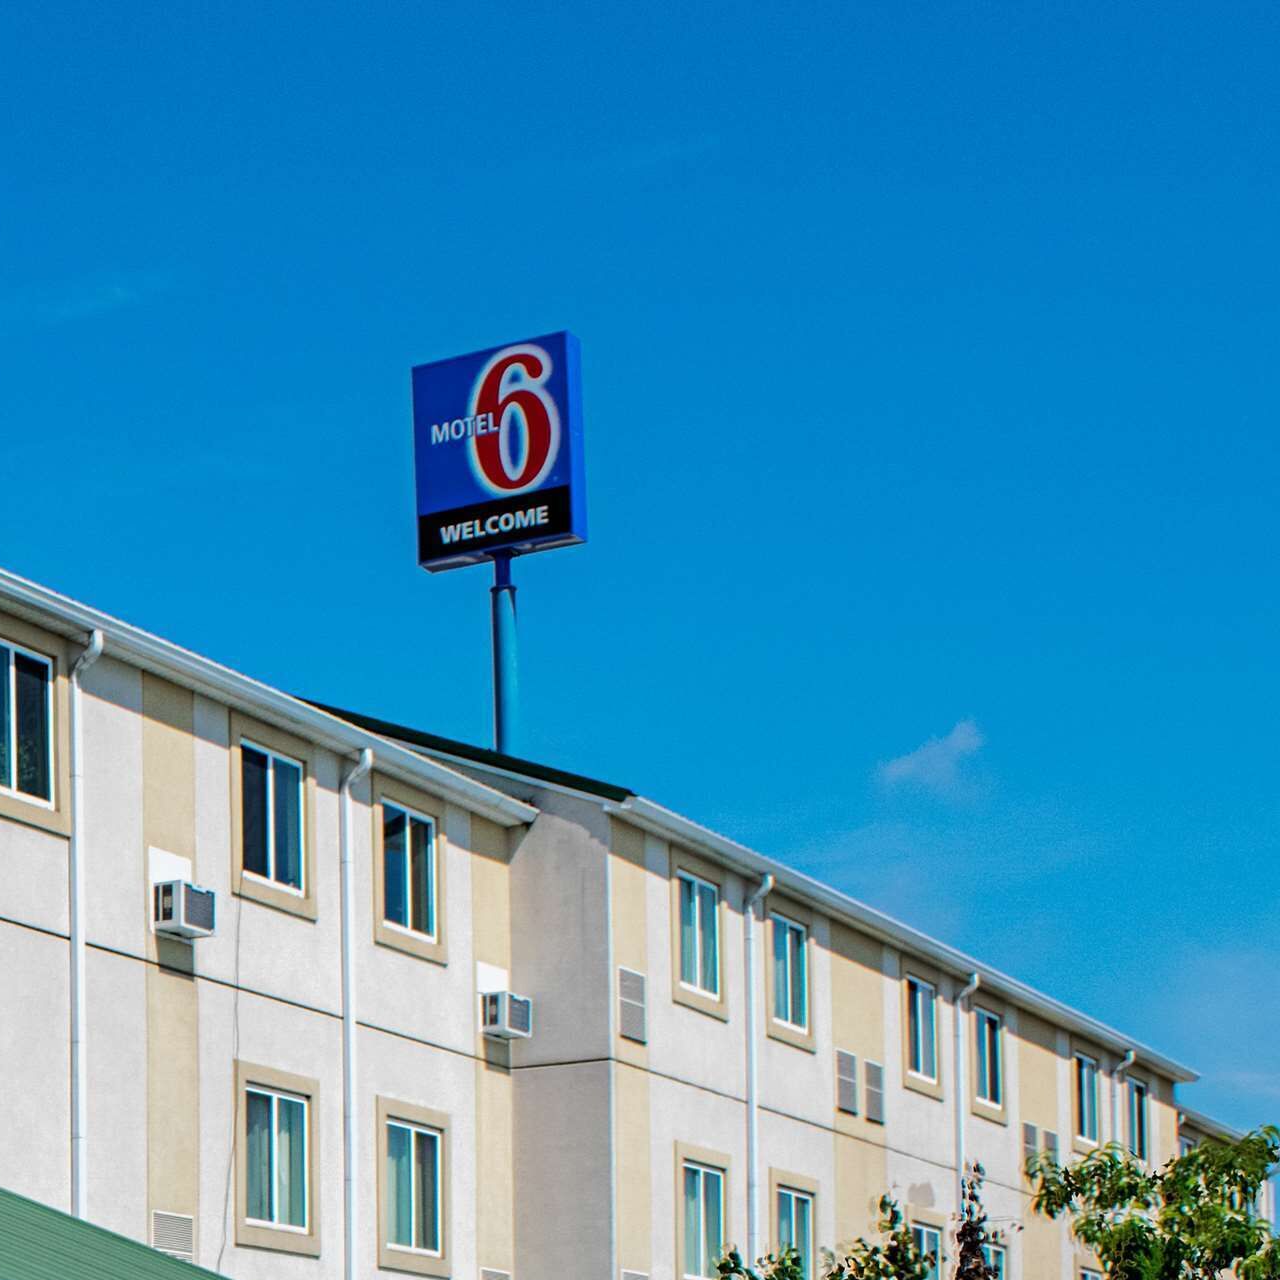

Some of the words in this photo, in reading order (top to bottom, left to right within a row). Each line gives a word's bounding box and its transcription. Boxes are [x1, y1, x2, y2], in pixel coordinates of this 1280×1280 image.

[430, 412, 499, 445] MOTEL
[470, 344, 560, 496] 6
[440, 505, 549, 545] WELCOME
